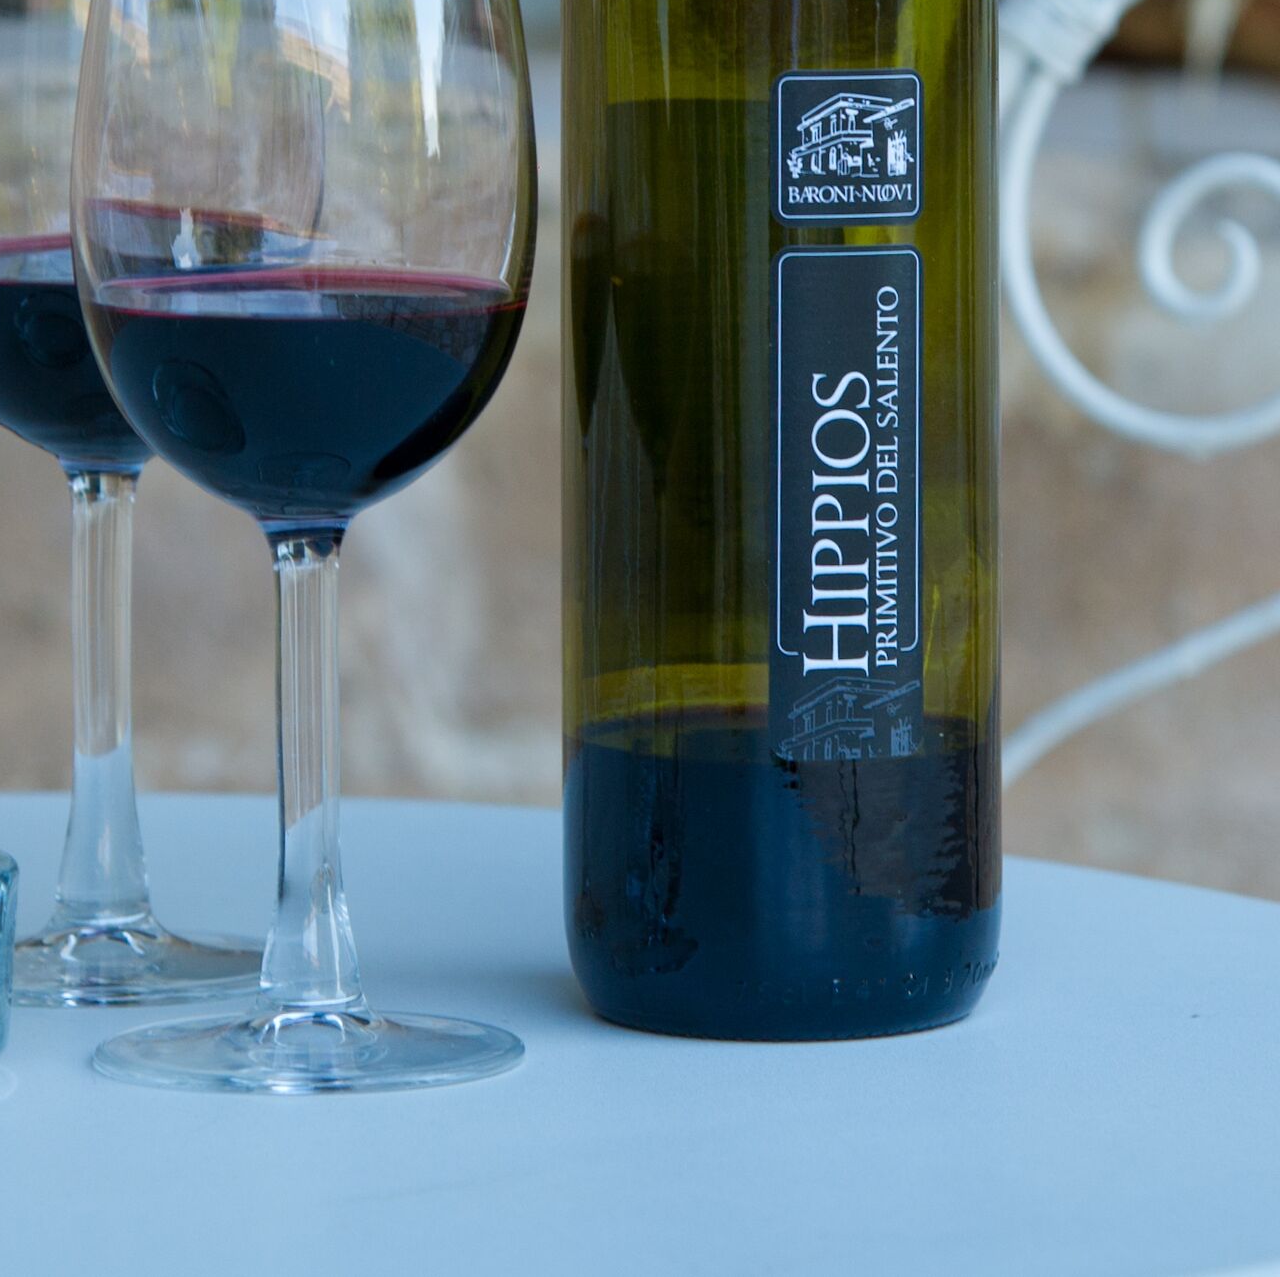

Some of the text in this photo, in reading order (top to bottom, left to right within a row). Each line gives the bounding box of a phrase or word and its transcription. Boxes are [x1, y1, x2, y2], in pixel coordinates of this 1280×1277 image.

[802, 371, 871, 677] HIPPIOS
[875, 285, 900, 667] PRIMITIVO DEL SALENTO
